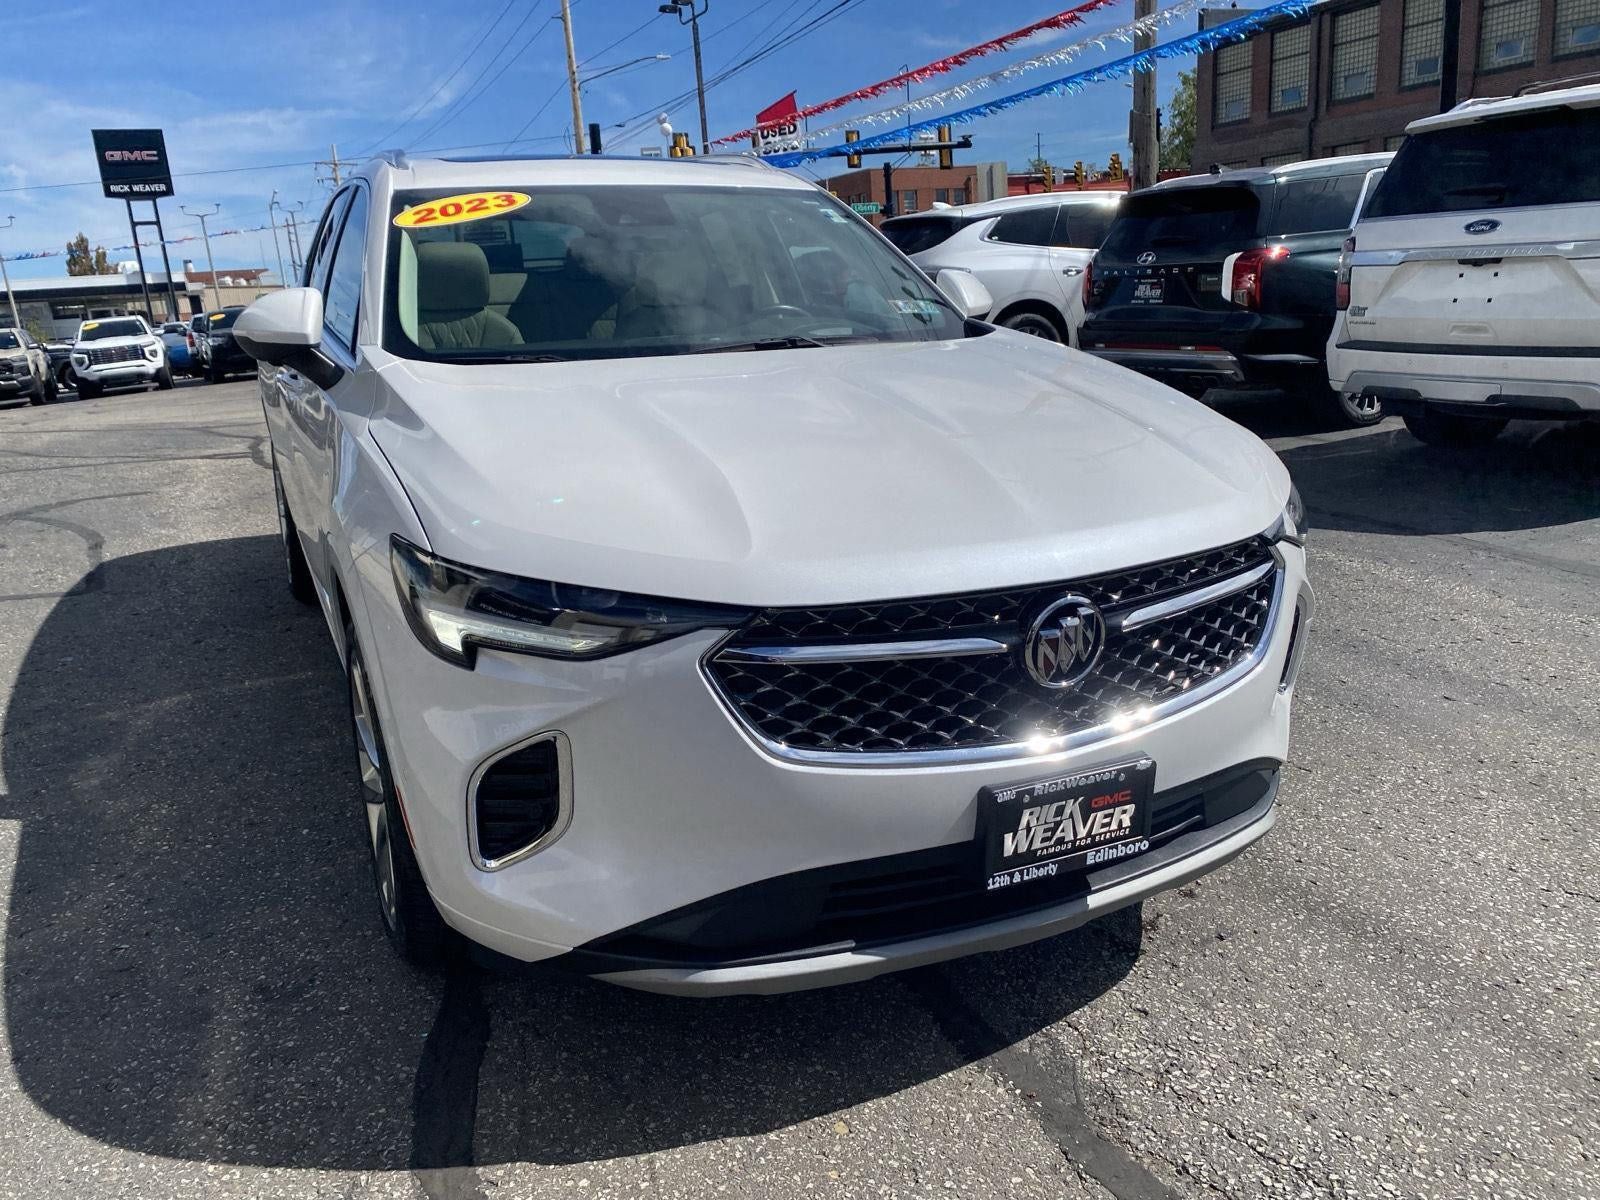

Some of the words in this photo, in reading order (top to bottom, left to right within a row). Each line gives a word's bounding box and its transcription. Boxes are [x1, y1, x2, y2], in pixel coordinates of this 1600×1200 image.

[761, 122, 797, 139] USED
[105, 150, 159, 161] GMC
[110, 184, 130, 192] RICK
[132, 183, 166, 192] WEAVER
[412, 194, 517, 224] 2023
[1091, 790, 1132, 808] GMC
[1018, 797, 1084, 831] RICK
[1003, 803, 1136, 858] WEAVER
[1037, 842, 1072, 857] FAMOUS
[1076, 837, 1091, 847] FOR
[1095, 828, 1130, 842] SERVICE
[1086, 839, 1149, 865] Edinboro
[987, 873, 1010, 890] 12th
[1013, 873, 1021, 884] &
[1023, 863, 1058, 881] Liberty
